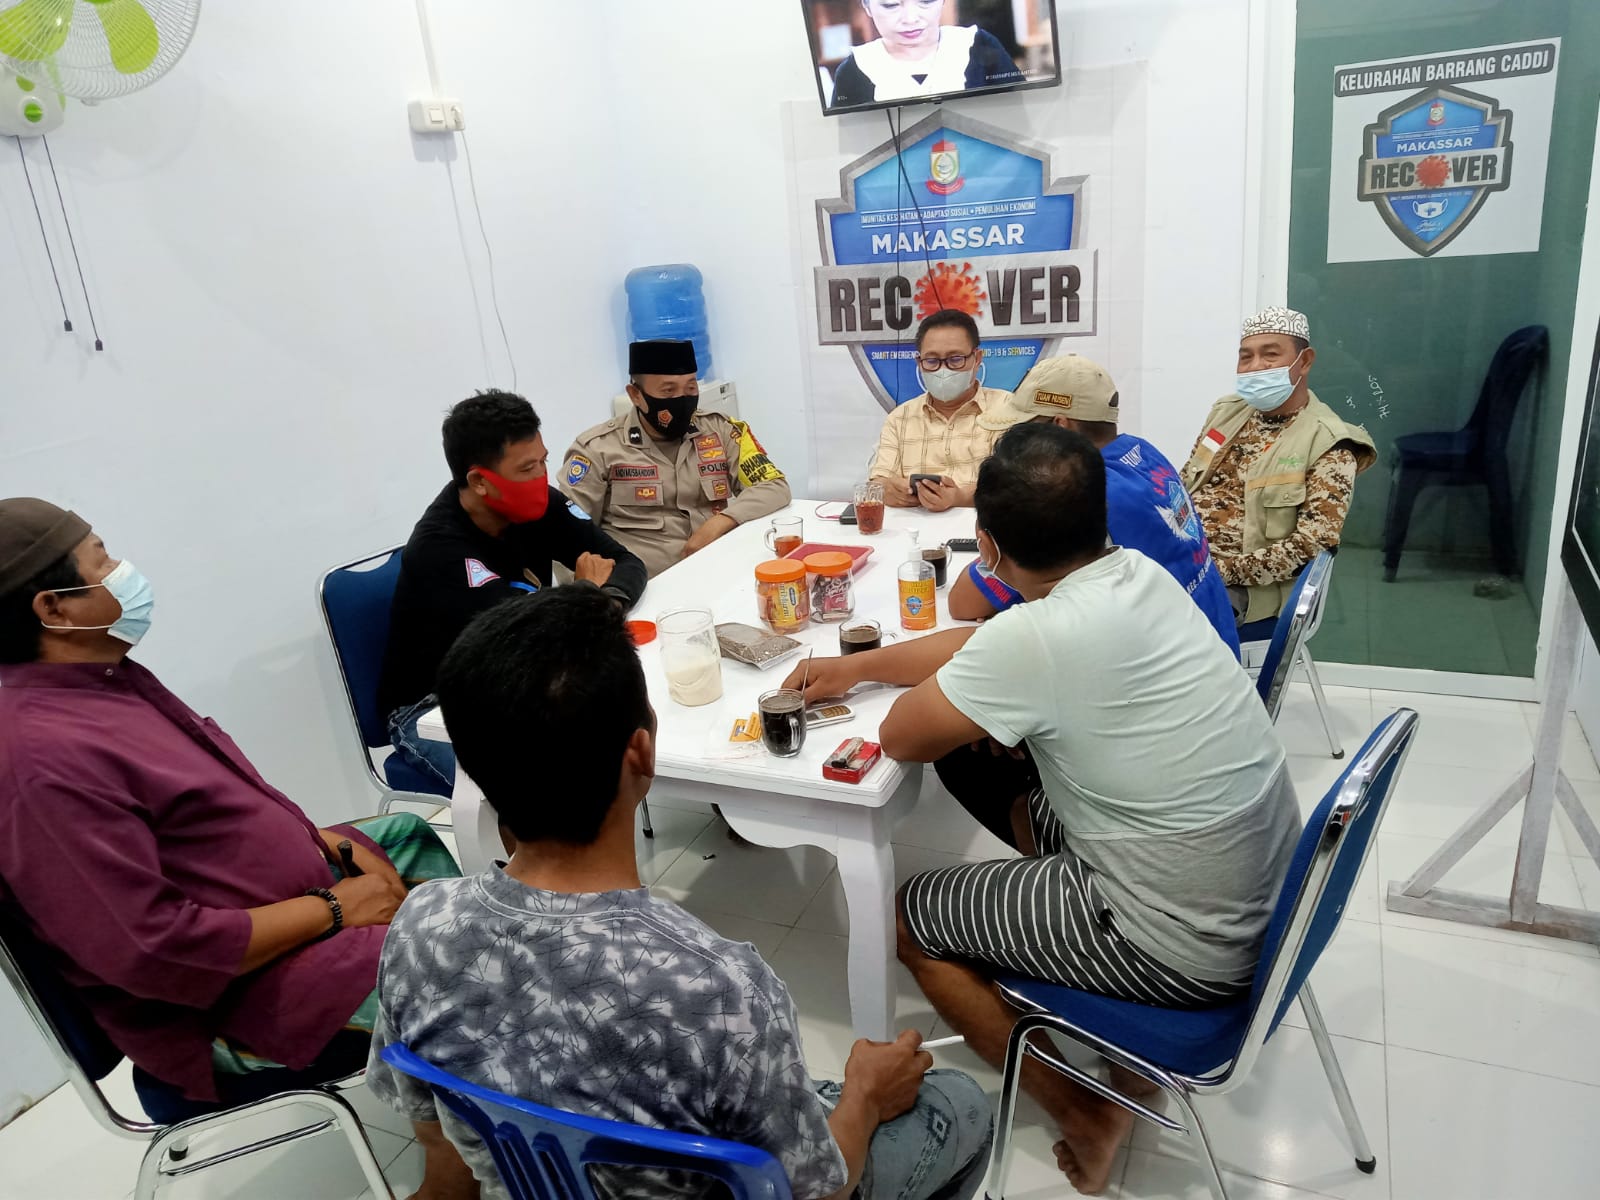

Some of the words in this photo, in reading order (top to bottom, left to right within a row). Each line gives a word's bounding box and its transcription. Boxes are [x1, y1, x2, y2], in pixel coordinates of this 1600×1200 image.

[1339, 66, 1421, 92] KELURAHAN
[1425, 57, 1496, 82] BARRANG
[1501, 50, 1549, 73] CADDI
[1396, 137, 1473, 153] MAKASSAR
[950, 208, 969, 217] SOSIAL
[872, 223, 1025, 255] MAKASSAR
[871, 351, 889, 360] SMART
[890, 350, 920, 360] EMERGENC
[1007, 346, 1036, 356] SERVICES
[700, 462, 728, 474] POLIS
